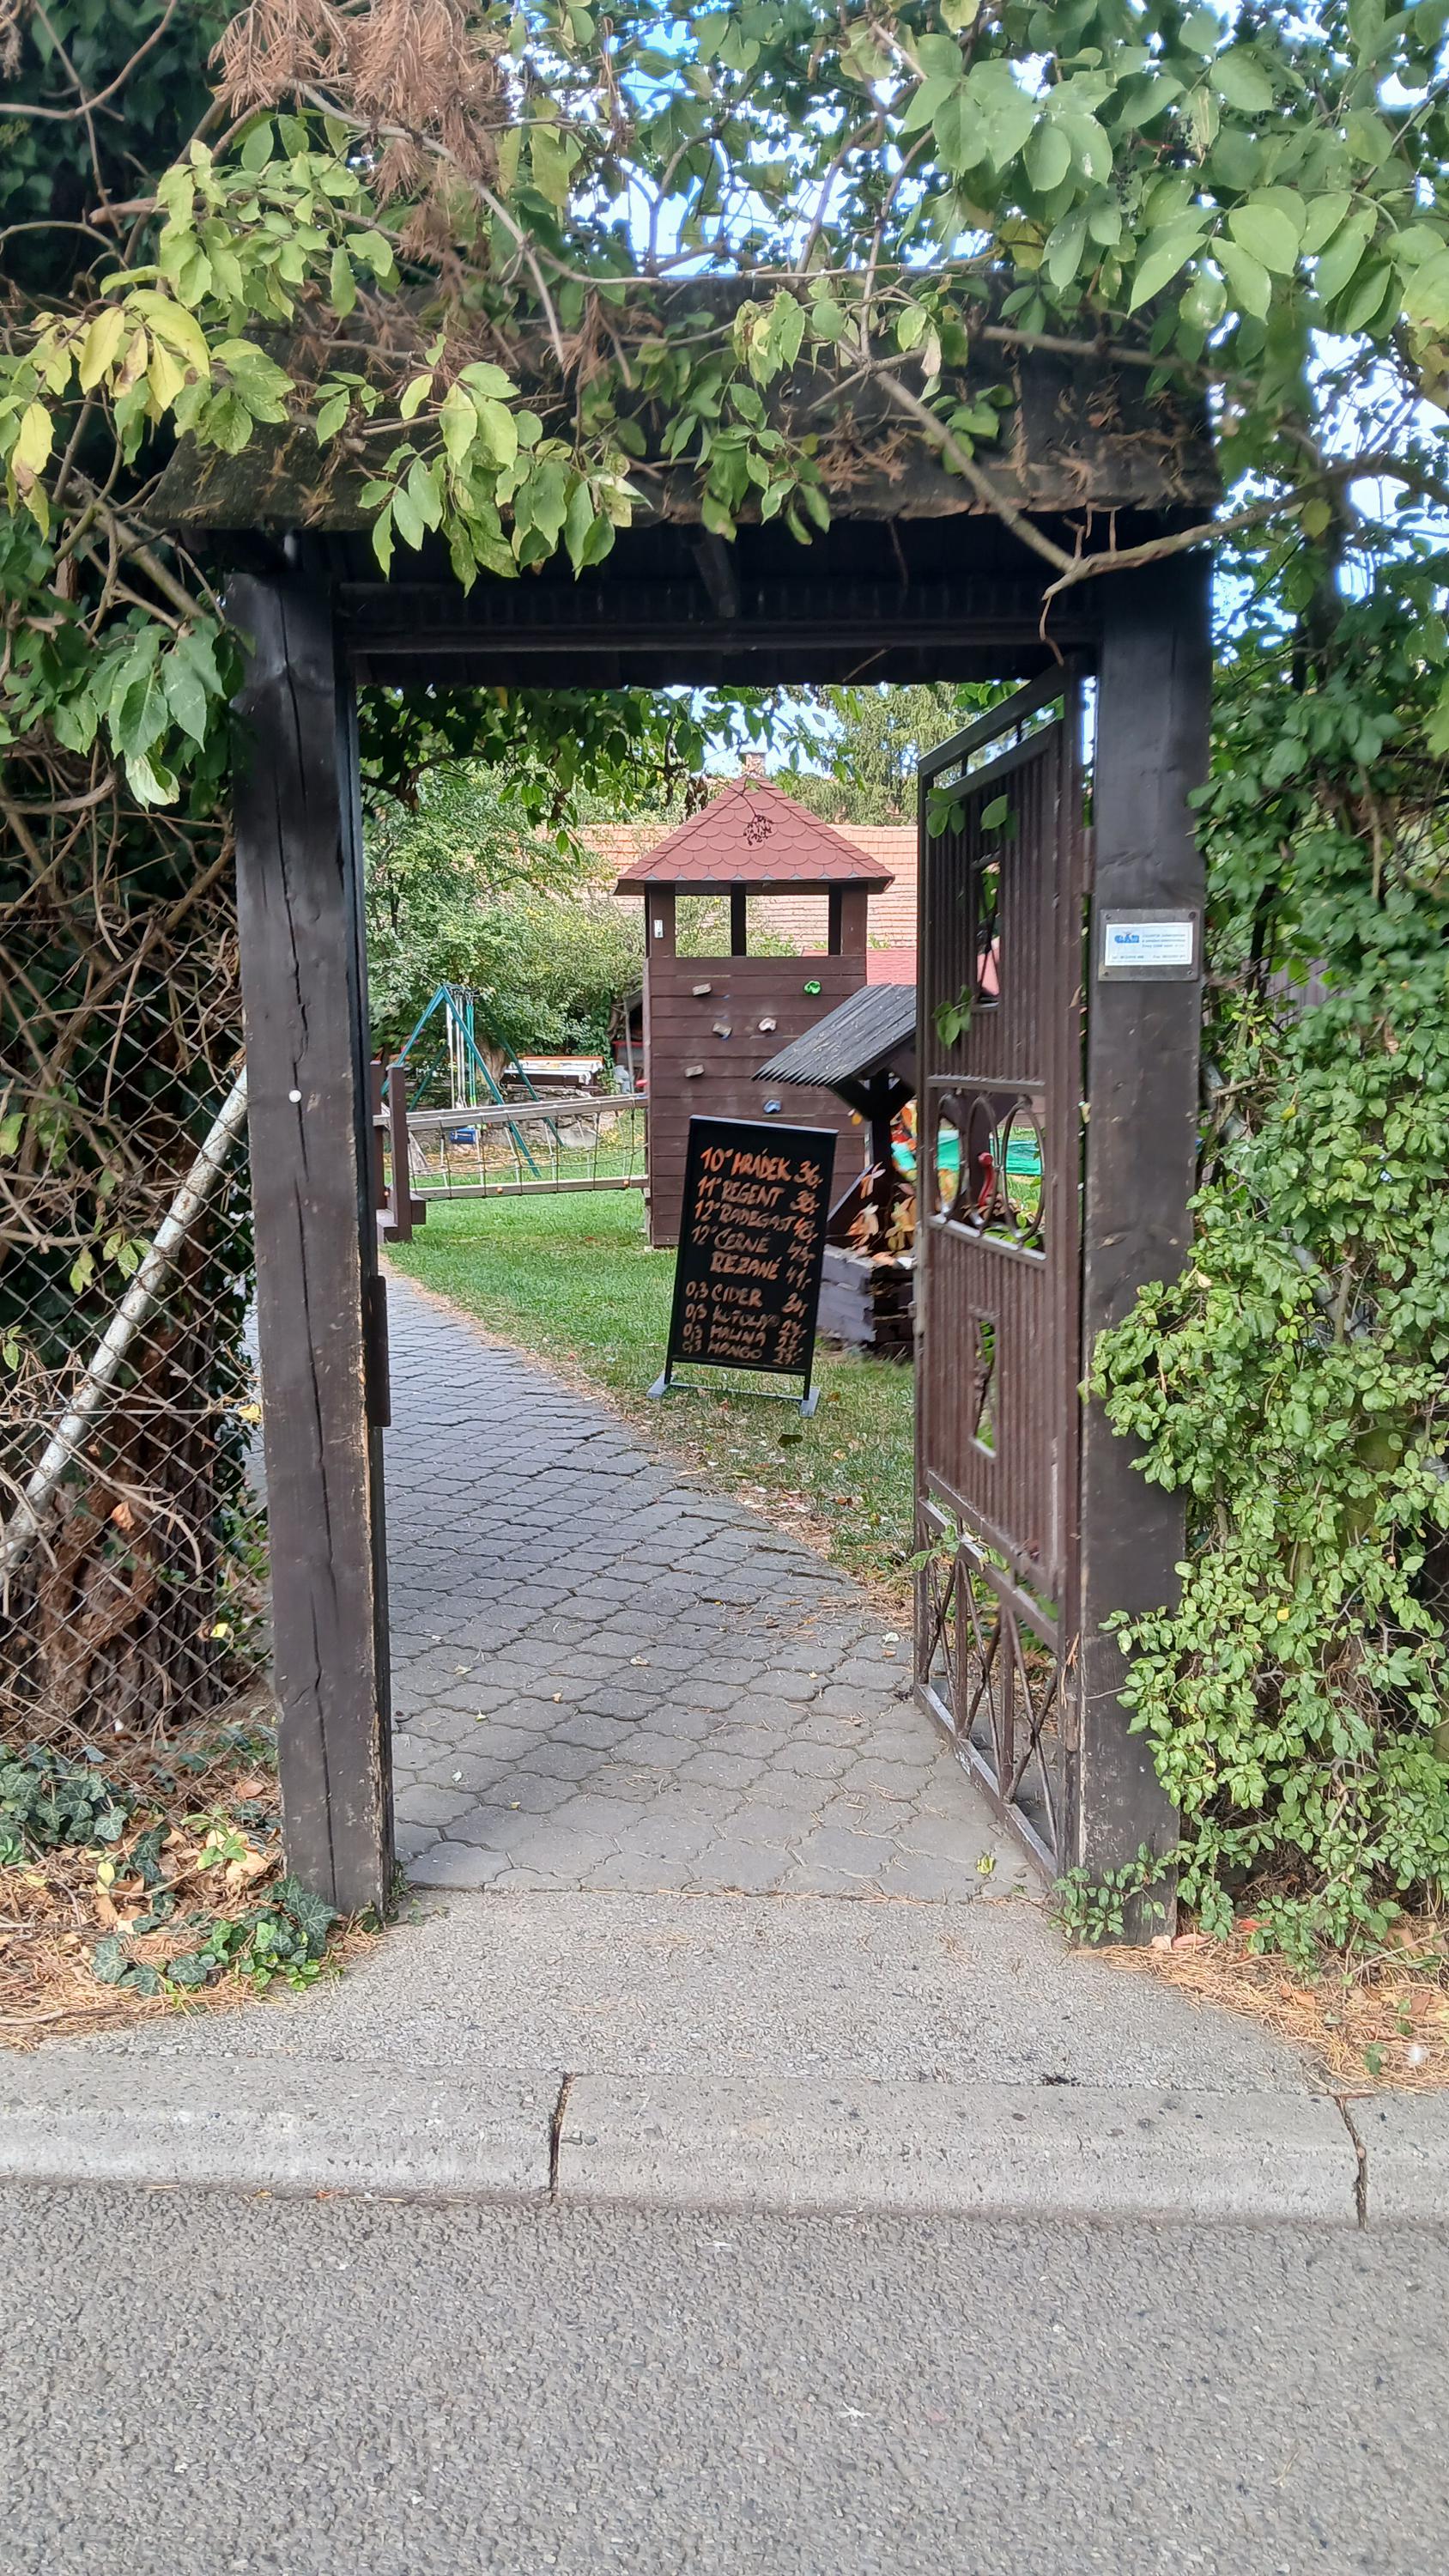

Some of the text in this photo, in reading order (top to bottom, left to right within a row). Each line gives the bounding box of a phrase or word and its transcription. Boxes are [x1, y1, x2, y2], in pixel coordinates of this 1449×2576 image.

[731, 1147, 791, 1182] HRÁDEK
[721, 1179, 785, 1207] REGENT
[718, 1203, 797, 1231] RADEGAST
[686, 1280, 708, 1300] 0,3
[712, 1283, 762, 1308] CIDER
[707, 1340, 762, 1359] MANGO
[710, 1325, 766, 1346] MALINA
